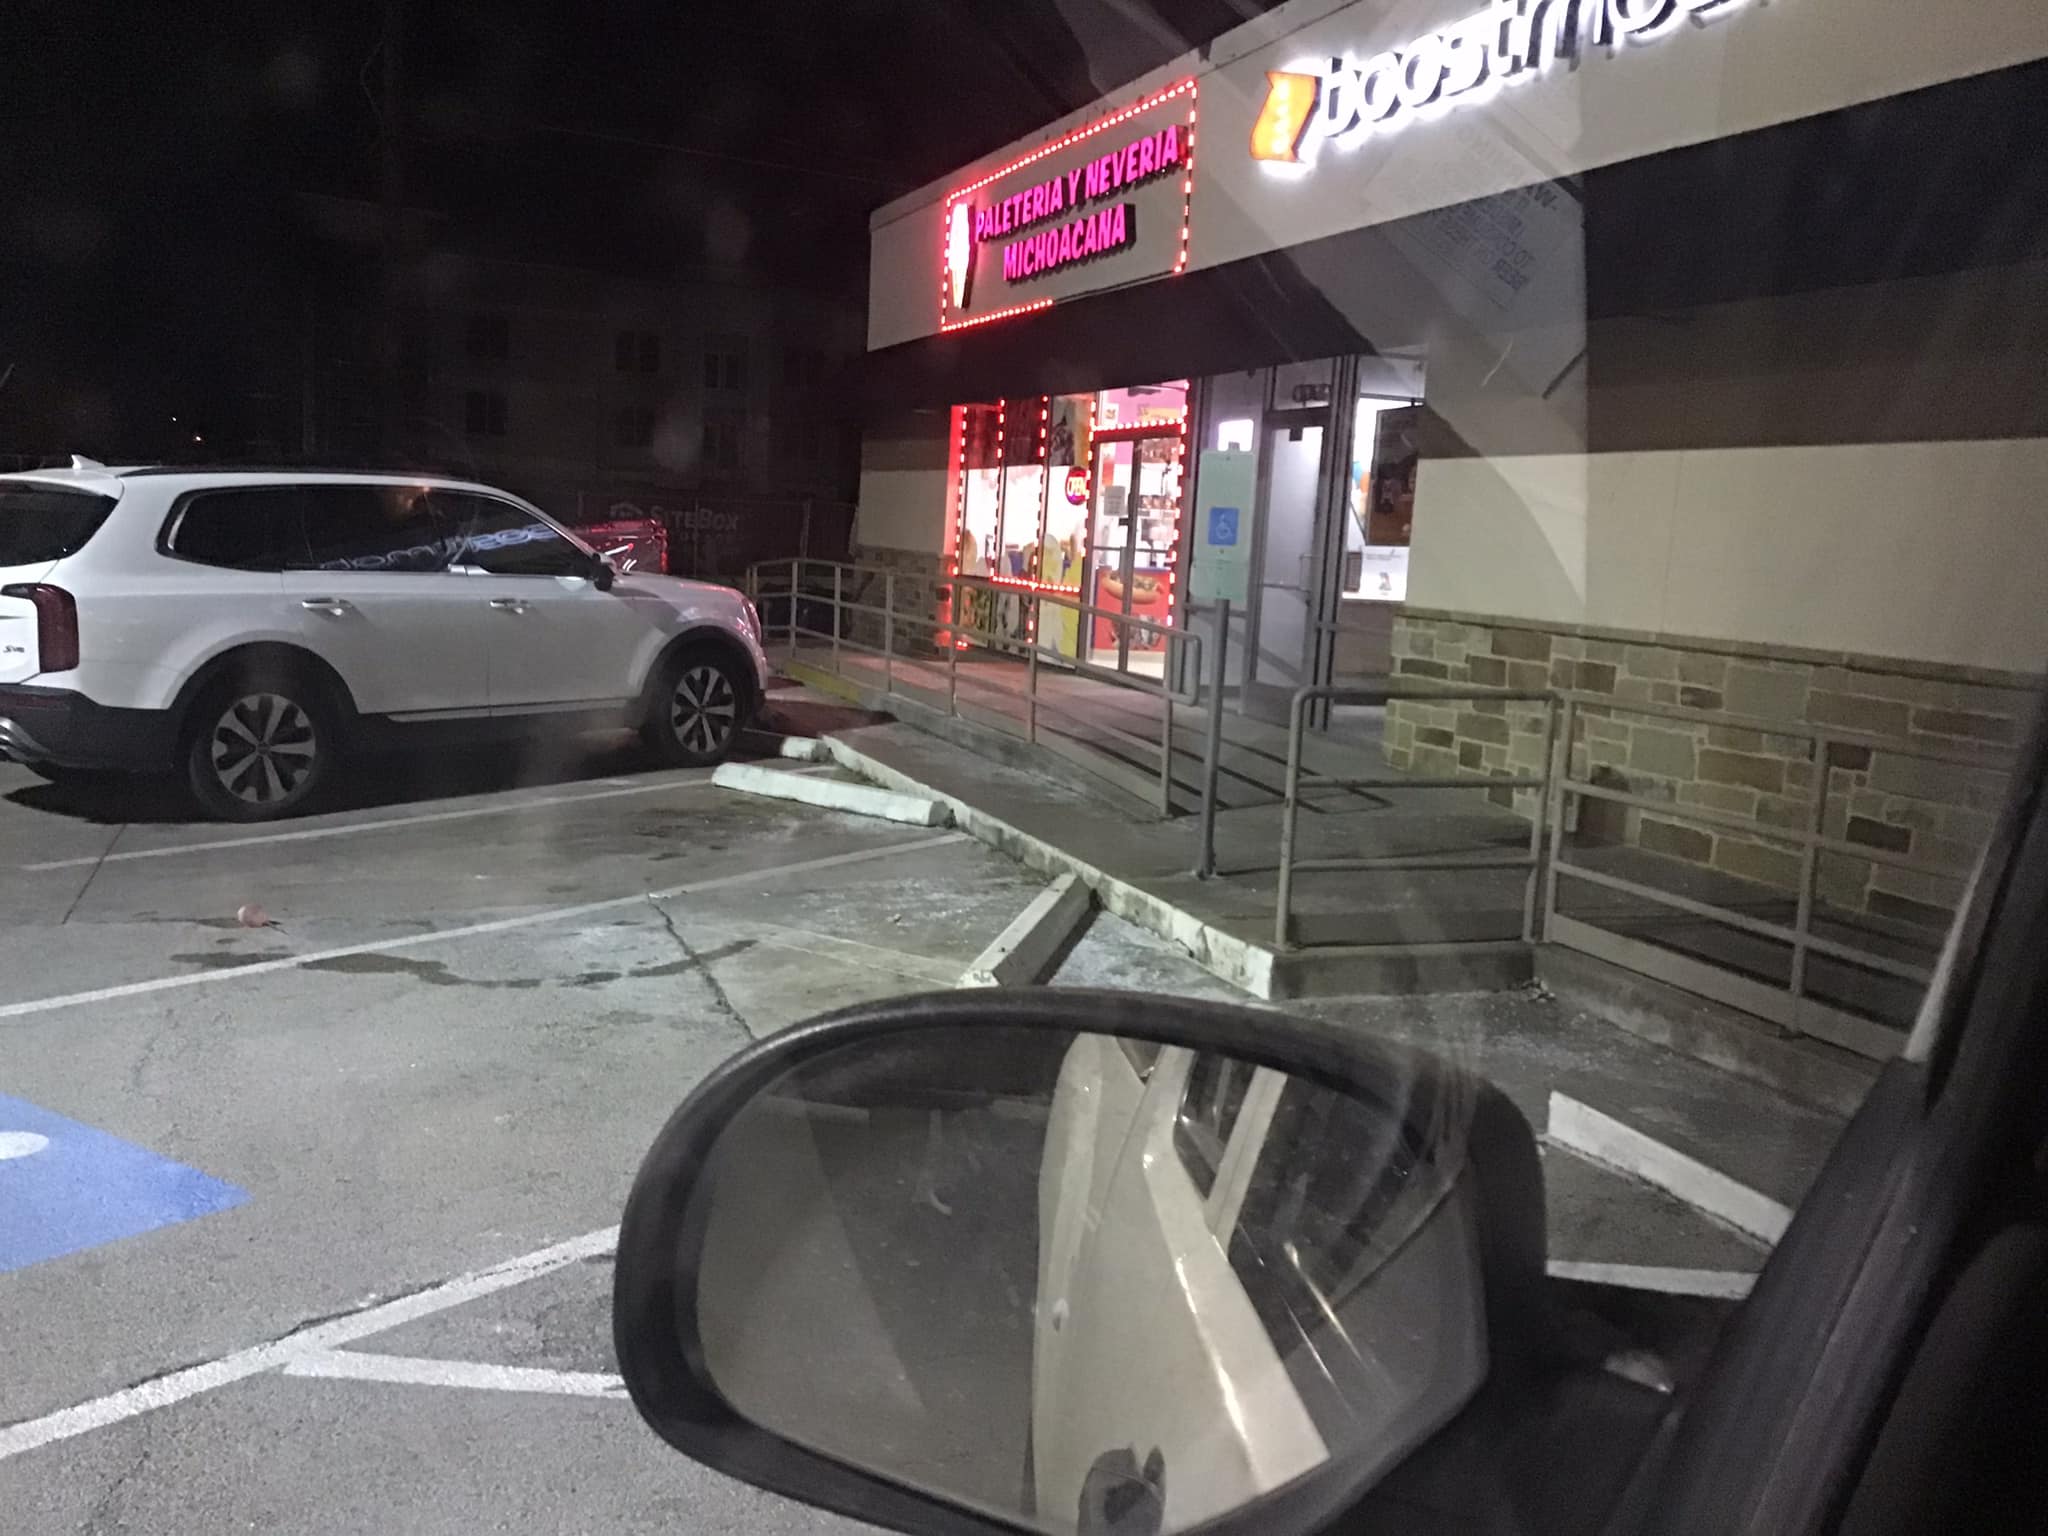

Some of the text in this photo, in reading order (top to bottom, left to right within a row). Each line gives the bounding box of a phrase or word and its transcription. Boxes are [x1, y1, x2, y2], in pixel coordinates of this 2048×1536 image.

[1318, 0, 1750, 140] boostmo
[974, 124, 1180, 243] PALETERIA Y NEVERIA
[1002, 203, 1127, 281] MICHOACANA
